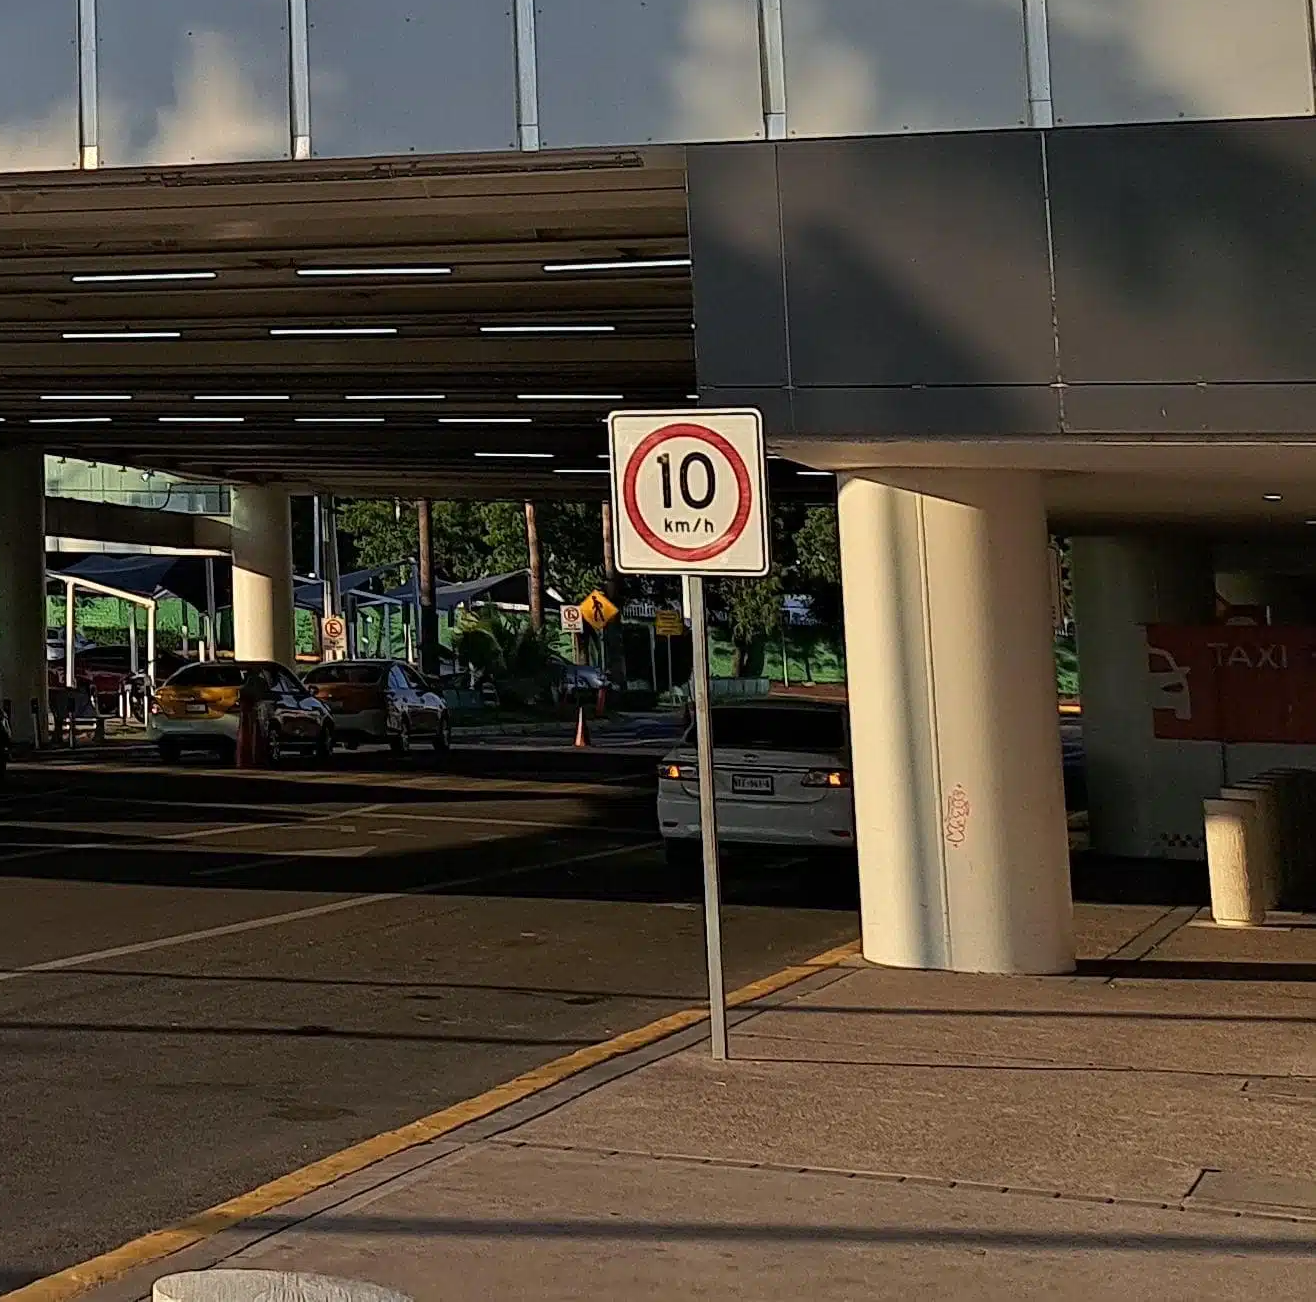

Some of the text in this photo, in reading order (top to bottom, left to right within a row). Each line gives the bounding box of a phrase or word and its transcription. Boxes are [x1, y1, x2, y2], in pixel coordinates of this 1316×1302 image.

[656, 451, 716, 510] 10
[664, 517, 715, 533] km/h
[1206, 642, 1289, 669] TAXI
